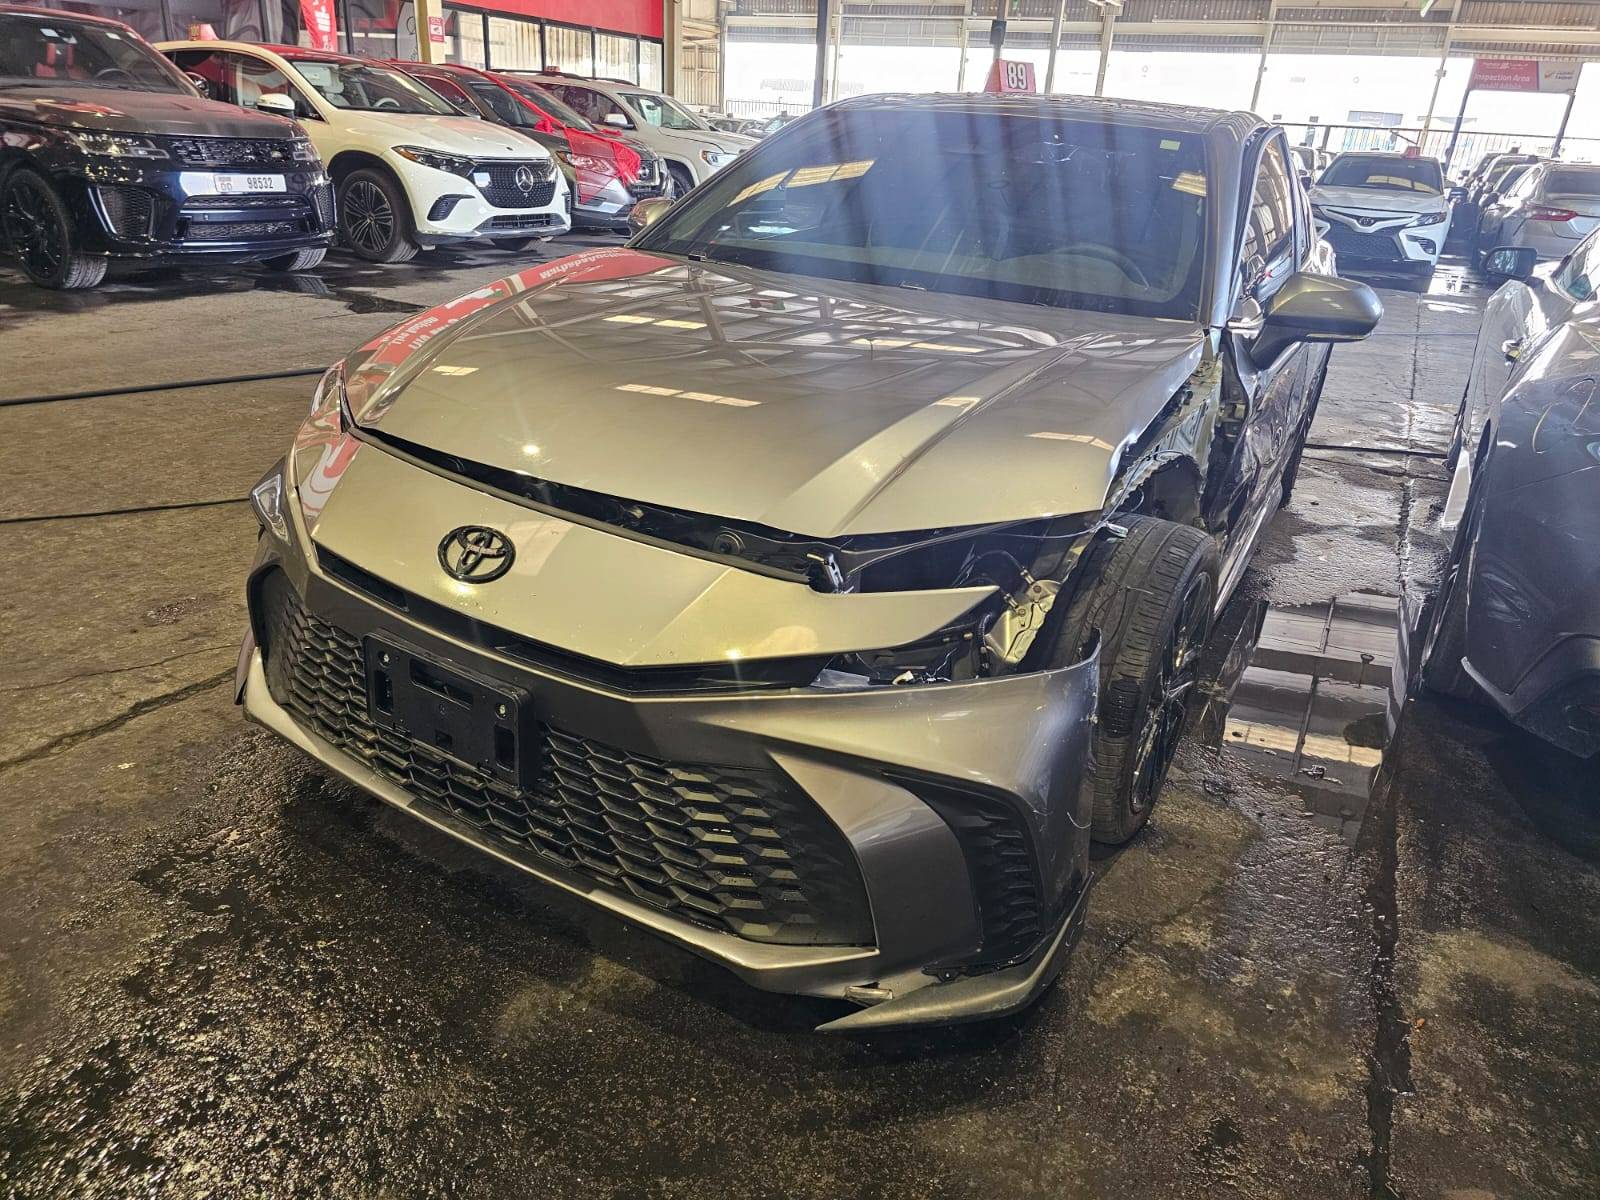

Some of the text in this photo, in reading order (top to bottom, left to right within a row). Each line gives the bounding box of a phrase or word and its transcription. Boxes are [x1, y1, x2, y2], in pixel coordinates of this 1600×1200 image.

[1008, 62, 1027, 90] 89
[1473, 72, 1531, 82] Inspection Area
[246, 177, 274, 190] 98532
